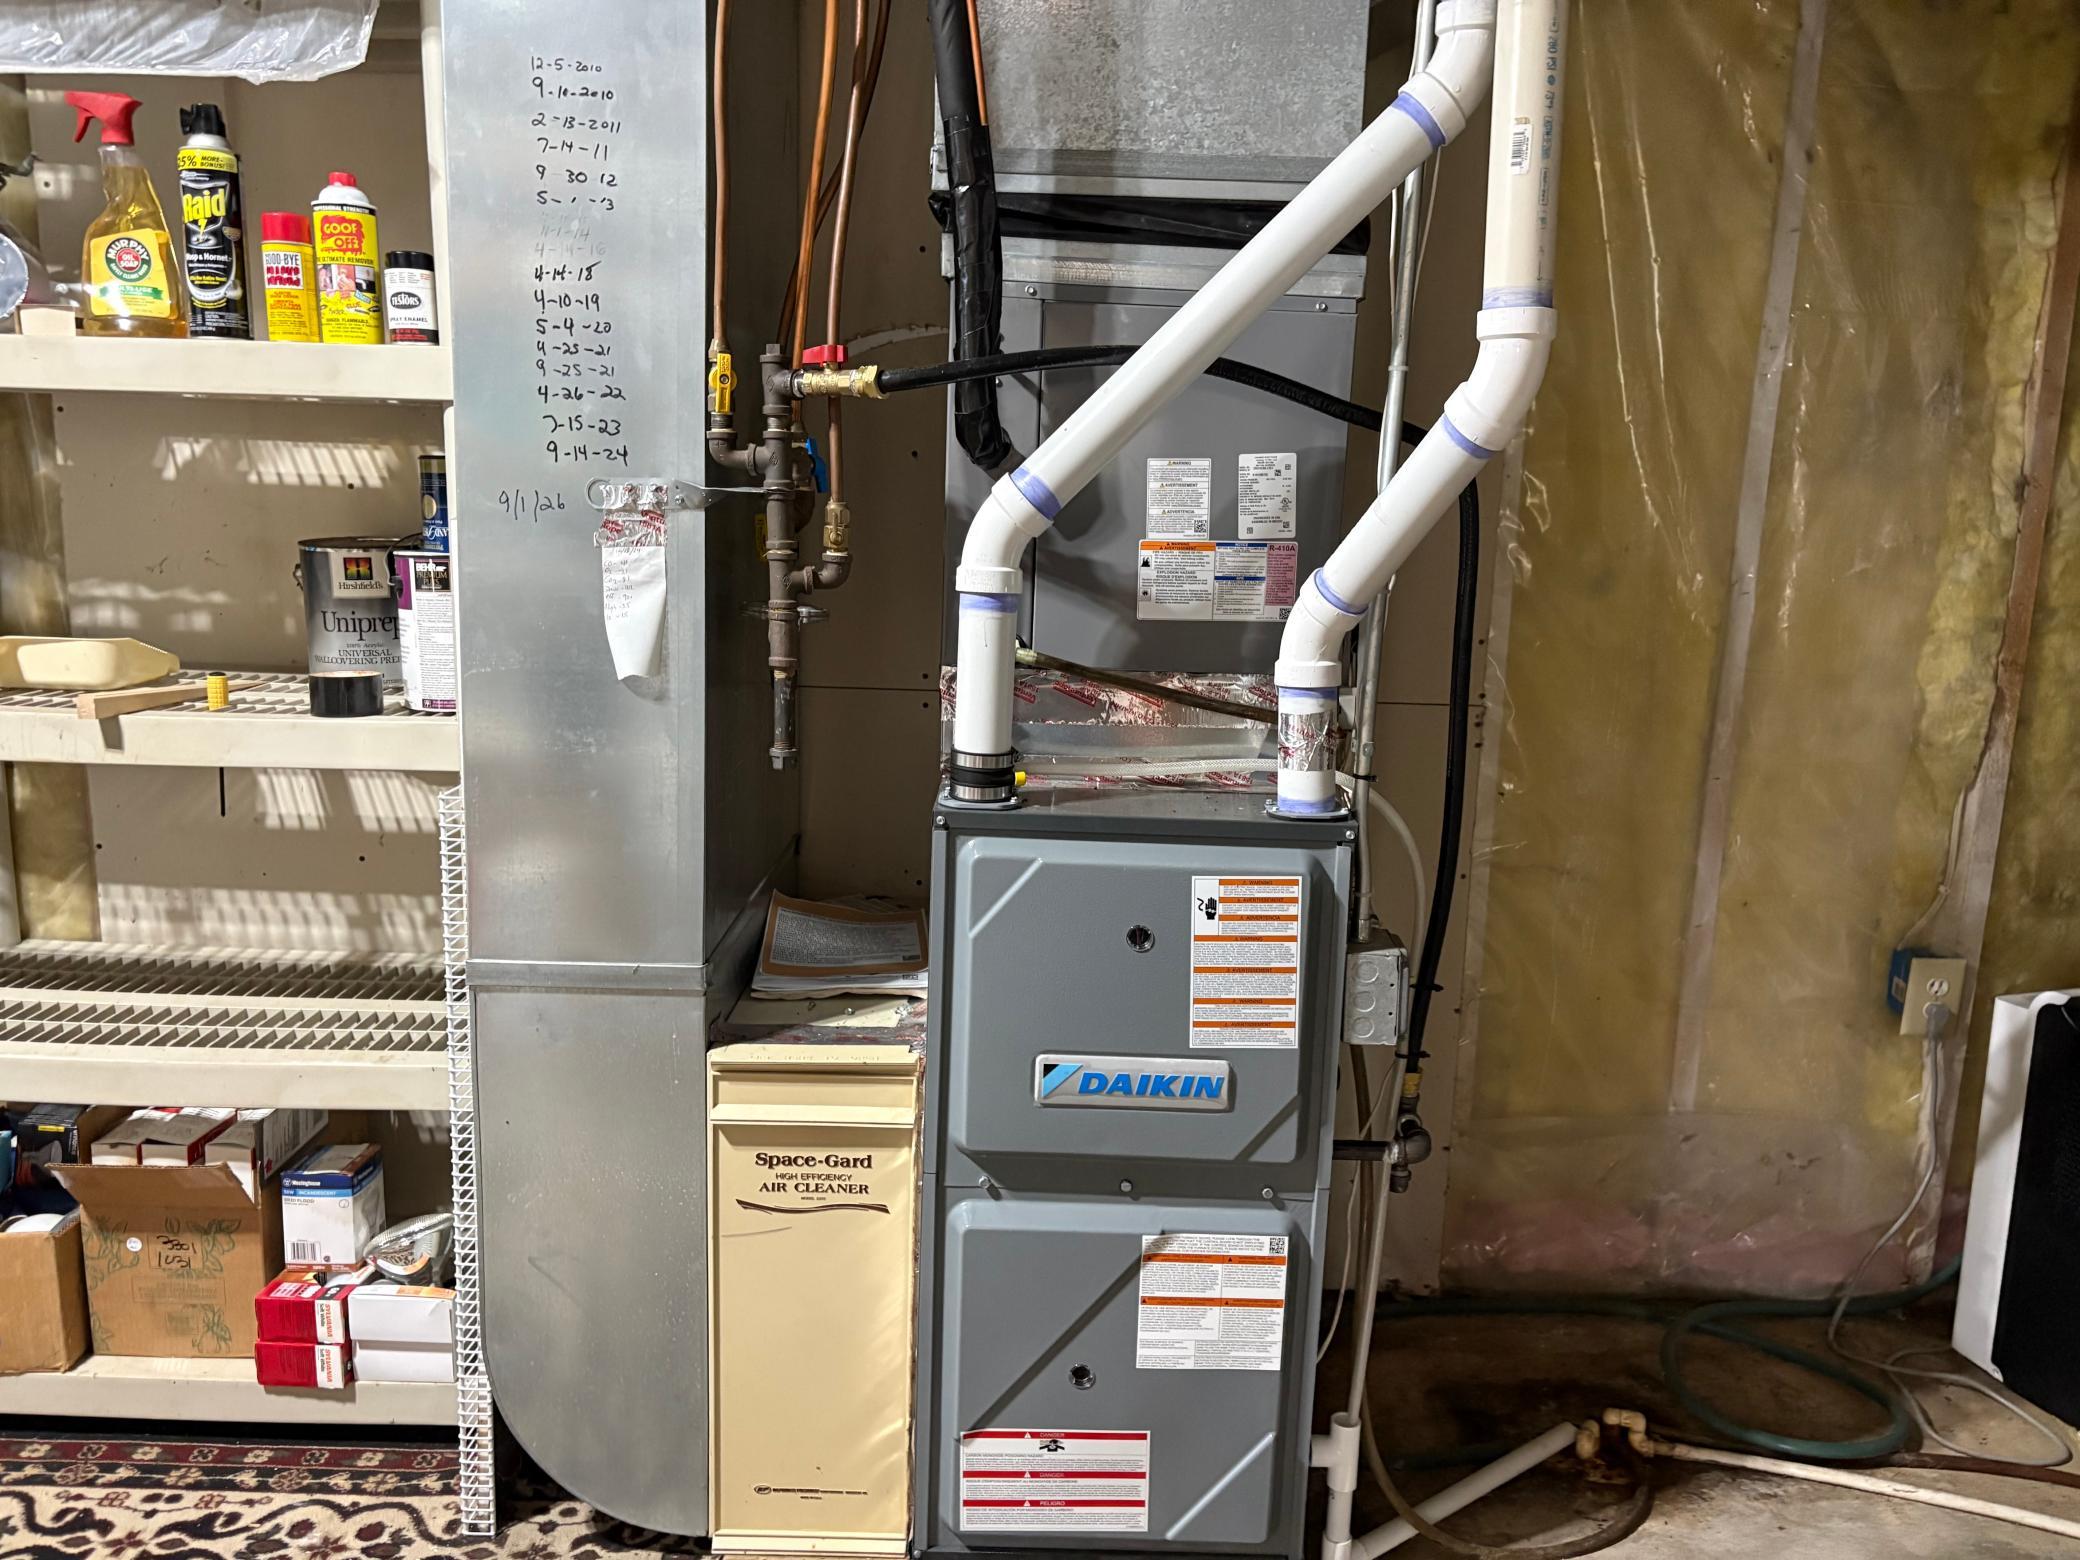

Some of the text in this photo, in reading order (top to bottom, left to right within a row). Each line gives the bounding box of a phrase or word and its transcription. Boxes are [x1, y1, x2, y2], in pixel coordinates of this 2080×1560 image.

[531, 55, 603, 73] 12-5-2010
[182, 188, 226, 224] Raid
[323, 222, 357, 235] GOOF
[106, 239, 150, 260] MURPHY
[334, 236, 360, 249] OFF
[120, 260, 139, 268] SOAP
[204, 252, 229, 262] Hornet
[391, 293, 420, 306] TESTORS
[534, 289, 600, 313] 4-10-19
[536, 317, 612, 337] 5-4-20
[537, 384, 627, 404] 4-26-22
[542, 414, 622, 436] 7-15-23
[546, 440, 629, 467] 9-14-24
[1269, 544, 1296, 552] R-410A
[416, 562, 436, 572] BEHR
[338, 581, 384, 590] Hirshfield's
[314, 655, 378, 665] WALLCOVERING
[338, 648, 392, 657] UNIVERSAL
[1078, 1071, 1226, 1099] DAIKIN
[755, 1152, 873, 1170] Space-Gard
[776, 1172, 853, 1182] HIGH EFFICIENCY
[759, 1182, 870, 1195] AIR CLEANER
[325, 1303, 333, 1338] SYLVANIA
[325, 1348, 333, 1383] SYLVANIA
